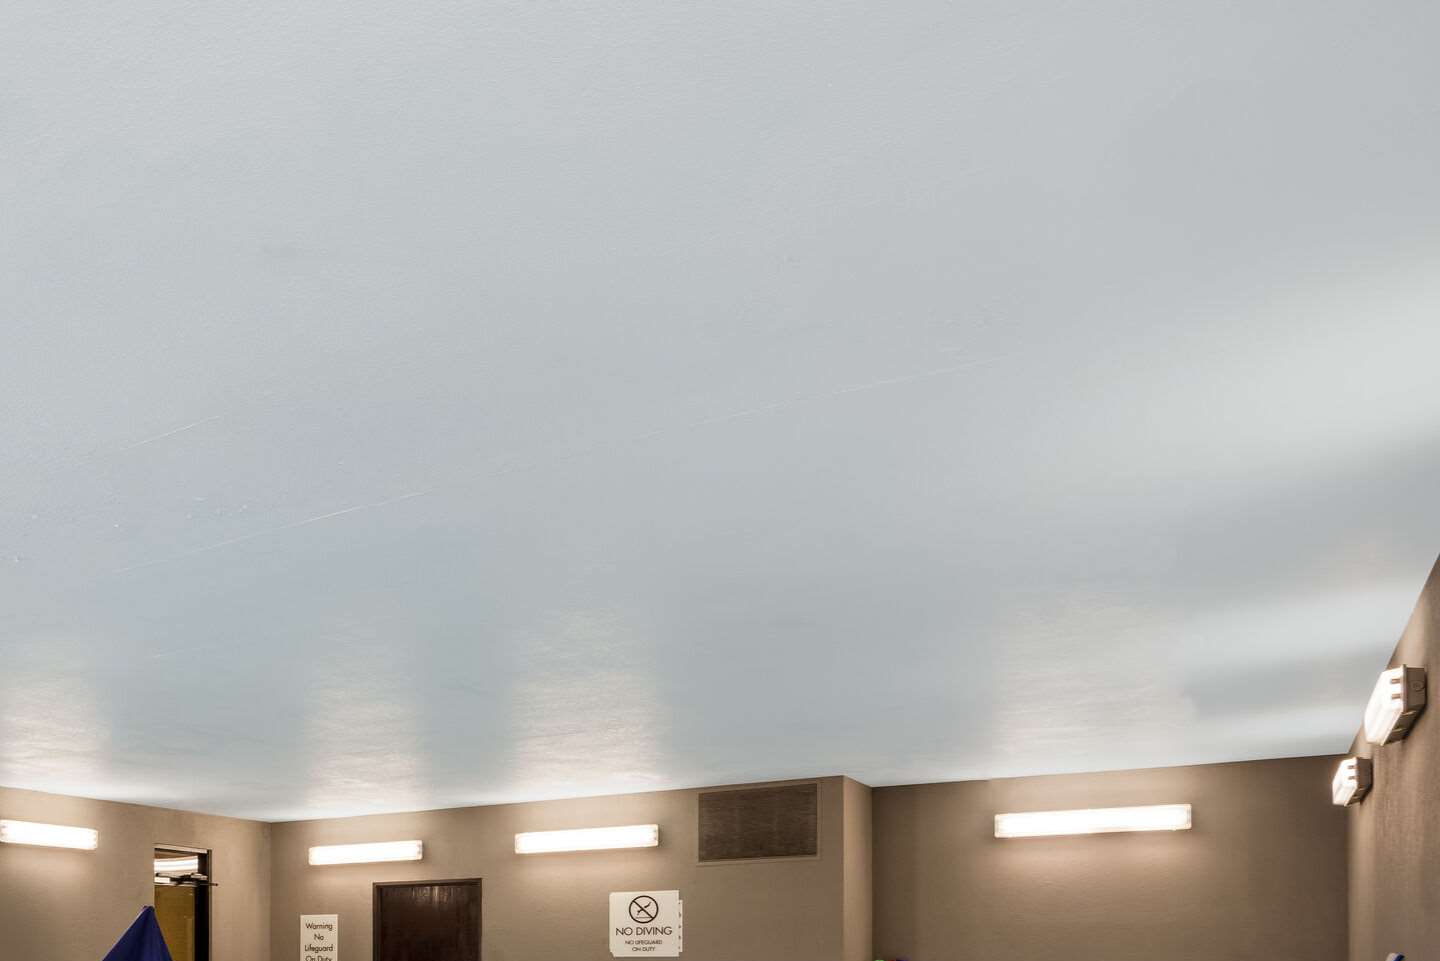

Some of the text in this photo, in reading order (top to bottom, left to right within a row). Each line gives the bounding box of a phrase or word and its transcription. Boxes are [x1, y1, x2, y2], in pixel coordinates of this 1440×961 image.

[305, 922, 333, 931] Warning
[615, 926, 673, 936] NO DIVING
[313, 933, 325, 941] No
[304, 943, 334, 954] Lifeguard
